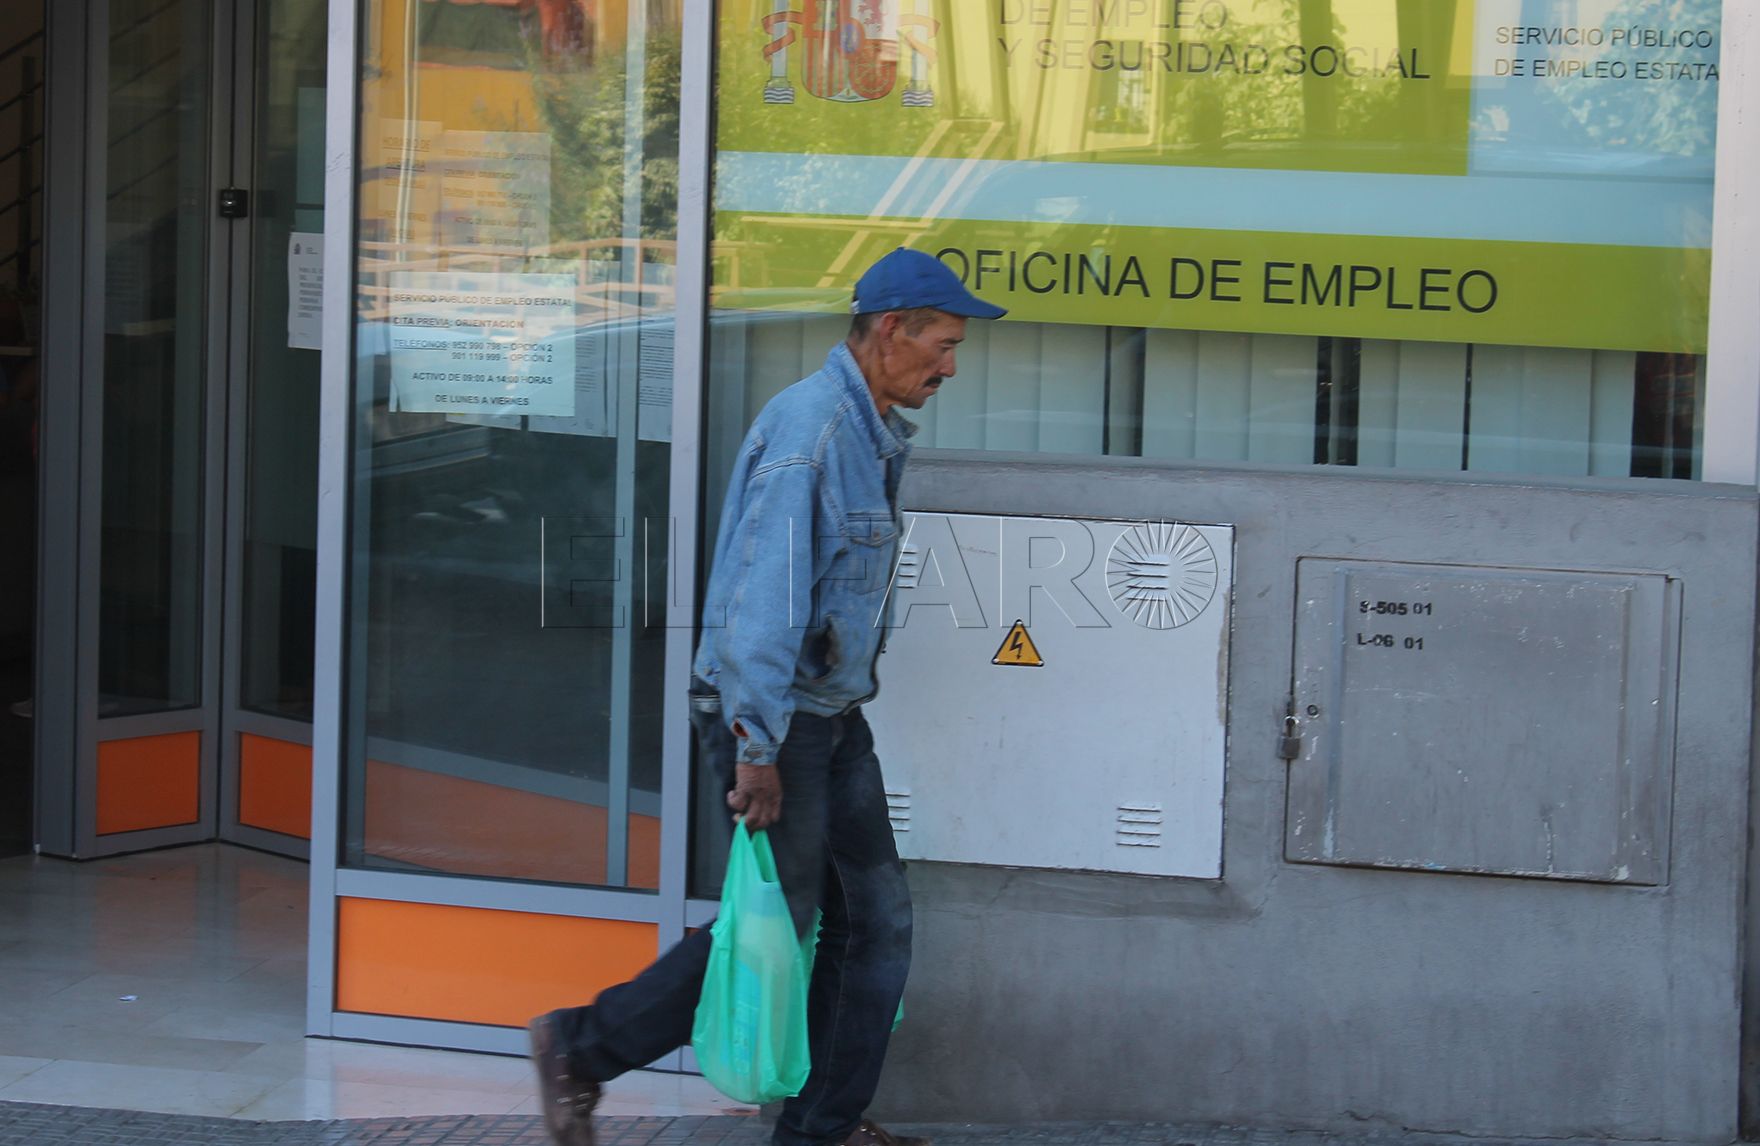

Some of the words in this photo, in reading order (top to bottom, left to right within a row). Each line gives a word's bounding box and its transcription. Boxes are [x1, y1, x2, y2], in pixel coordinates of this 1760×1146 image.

[1495, 26, 1604, 46] SERVICIO
[998, 37, 1023, 67] Y
[1035, 38, 1269, 75] SEGURIDAD
[1283, 44, 1431, 79] SOCIAL
[1495, 58, 1525, 77] DE
[1532, 59, 1627, 79] EMPLEO
[935, 247, 1151, 298] OFICINA
[1169, 257, 1242, 302] DE
[1263, 261, 1498, 313] EMPLEO
[393, 293, 437, 303] SERVICIO
[480, 296, 493, 305] DE
[495, 297, 532, 306] EMPLEO
[533, 298, 573, 307] ESTATAL
[392, 317, 415, 326] CITA
[547, 344, 553, 352] 2
[547, 355, 553, 363] 2
[412, 372, 447, 382] ACTIVO
[448, 373, 461, 382] DE
[486, 375, 495, 383] A
[520, 376, 554, 385] HORAS
[435, 394, 449, 403] DE
[450, 395, 479, 404] LUNES
[480, 396, 490, 404] A
[491, 396, 530, 406] VIERNES
[1357, 633, 1394, 648] L-06
[1404, 637, 1424, 650] 01
